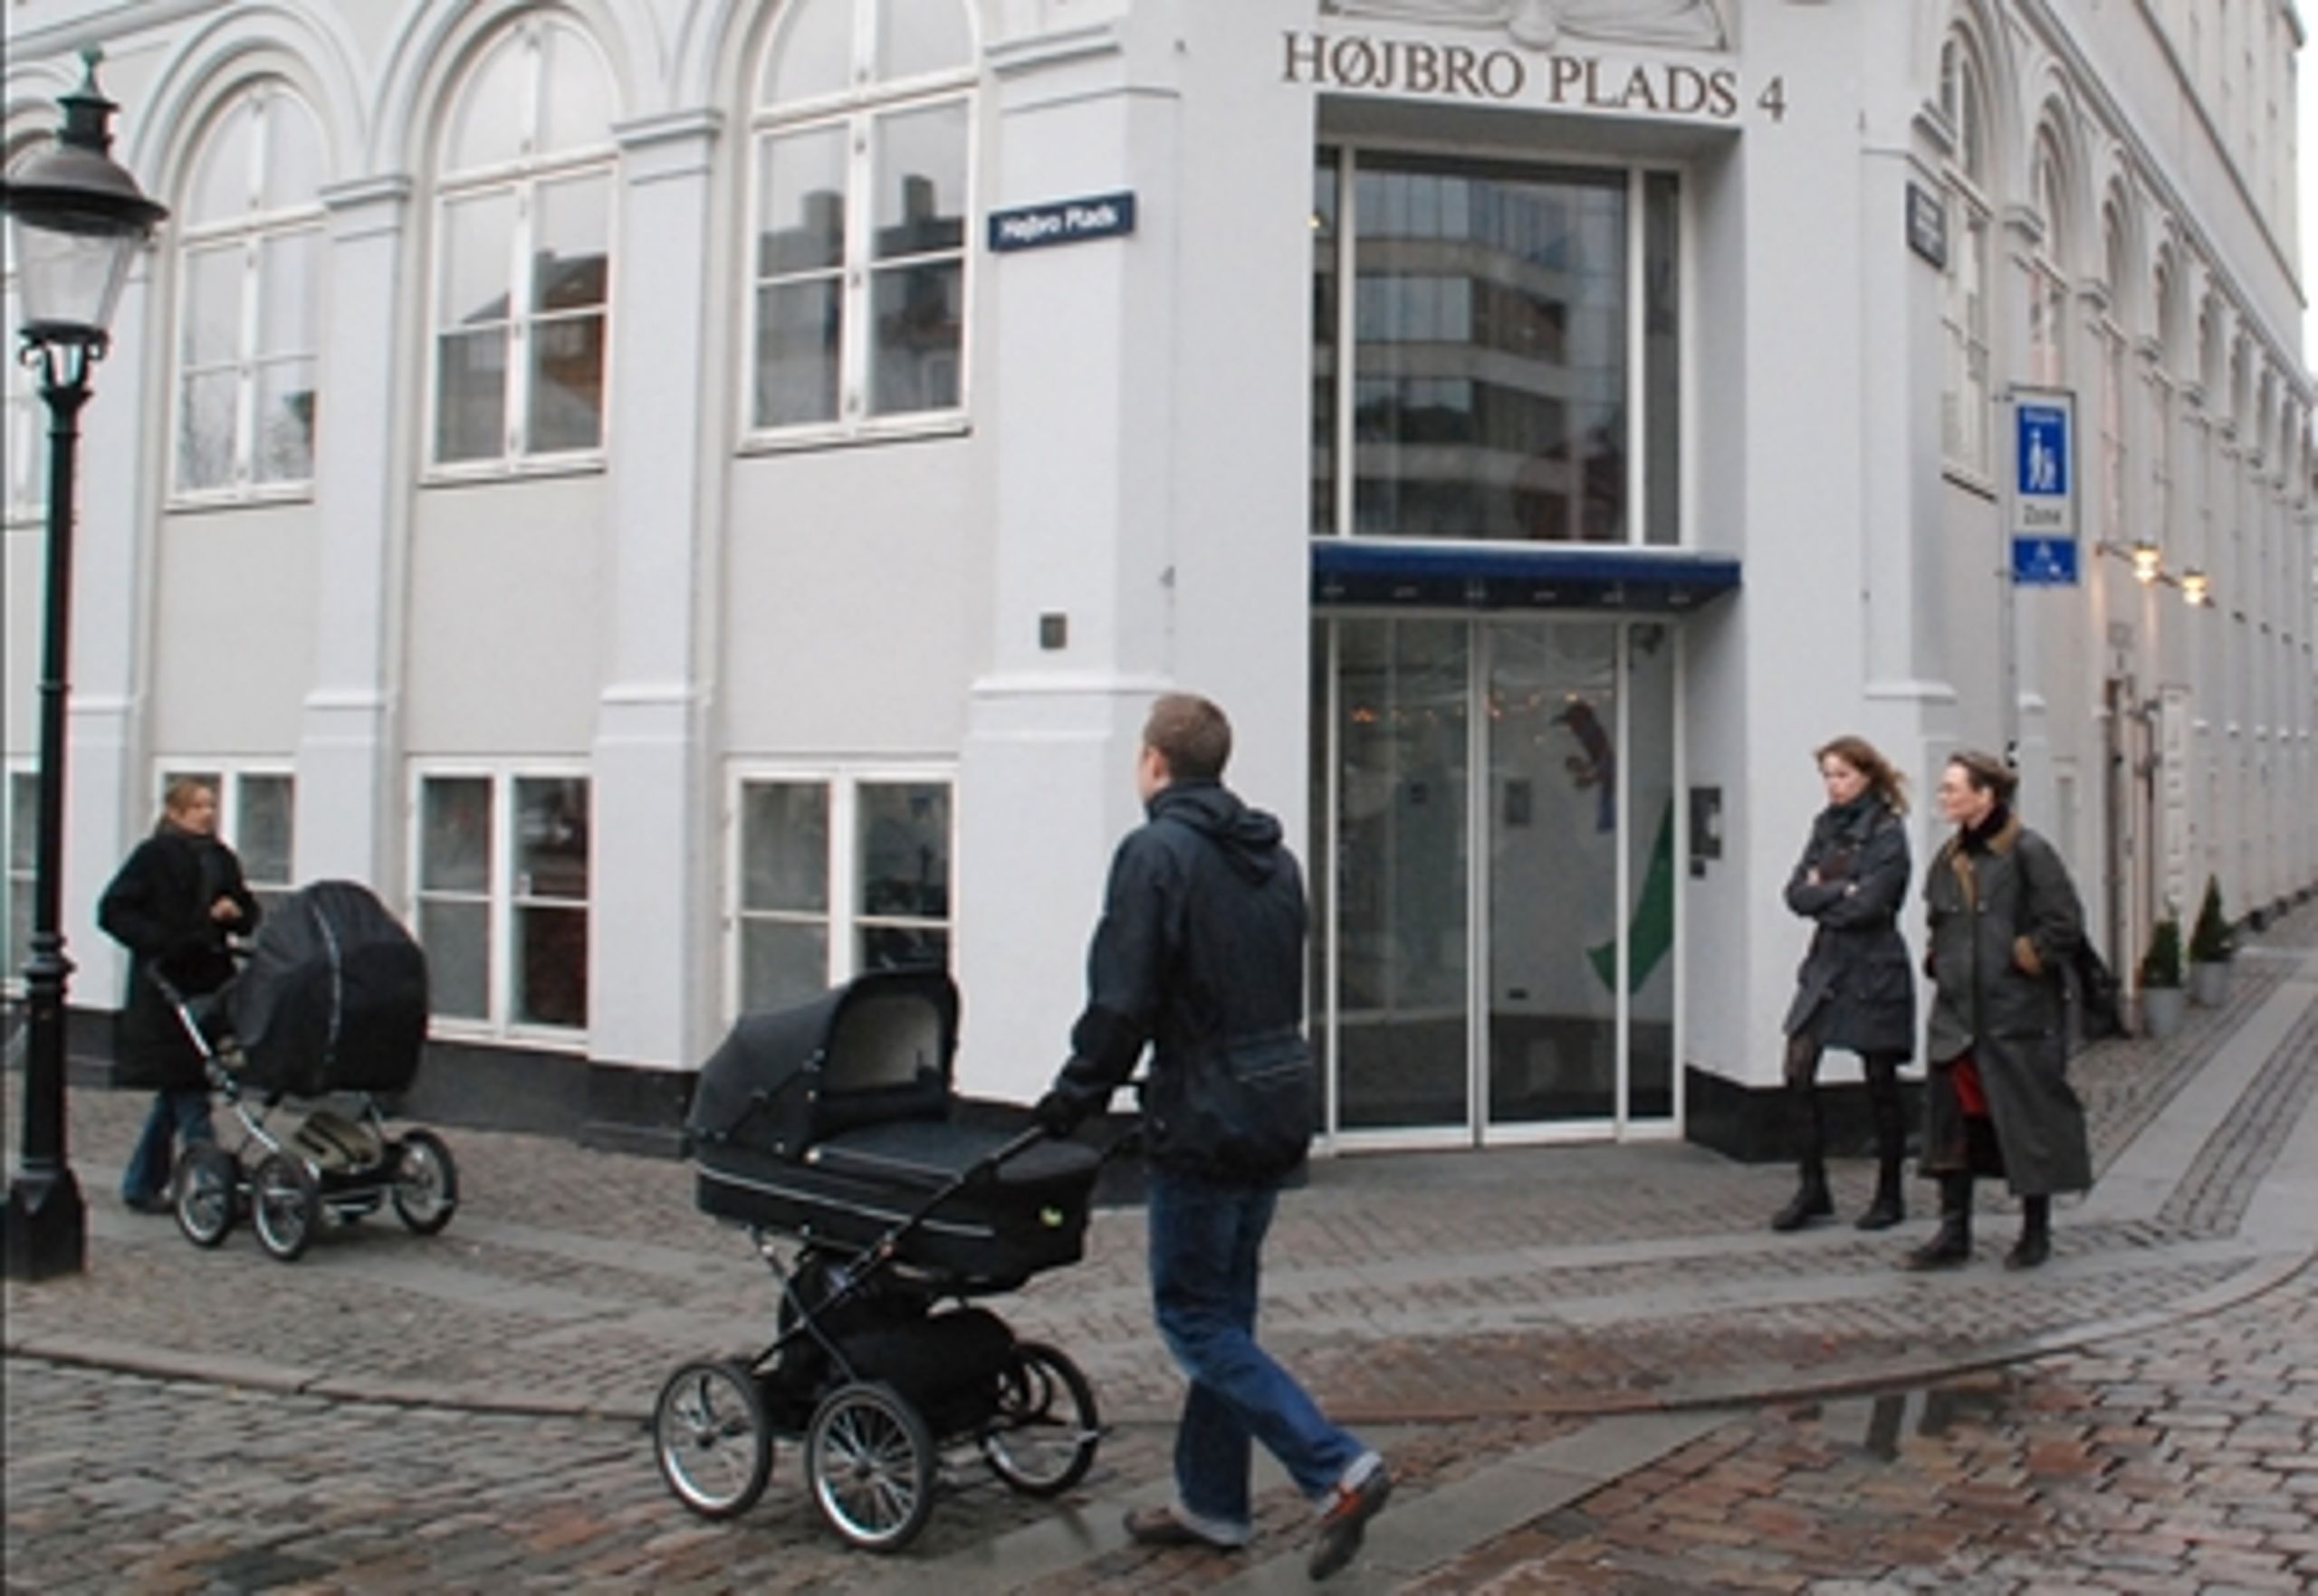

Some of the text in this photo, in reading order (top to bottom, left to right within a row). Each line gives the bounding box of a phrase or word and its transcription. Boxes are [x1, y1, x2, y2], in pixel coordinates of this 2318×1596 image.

[1281, 32, 1786, 121] HØJBRO PLADS 4
[1065, 204, 1118, 232] Plads
